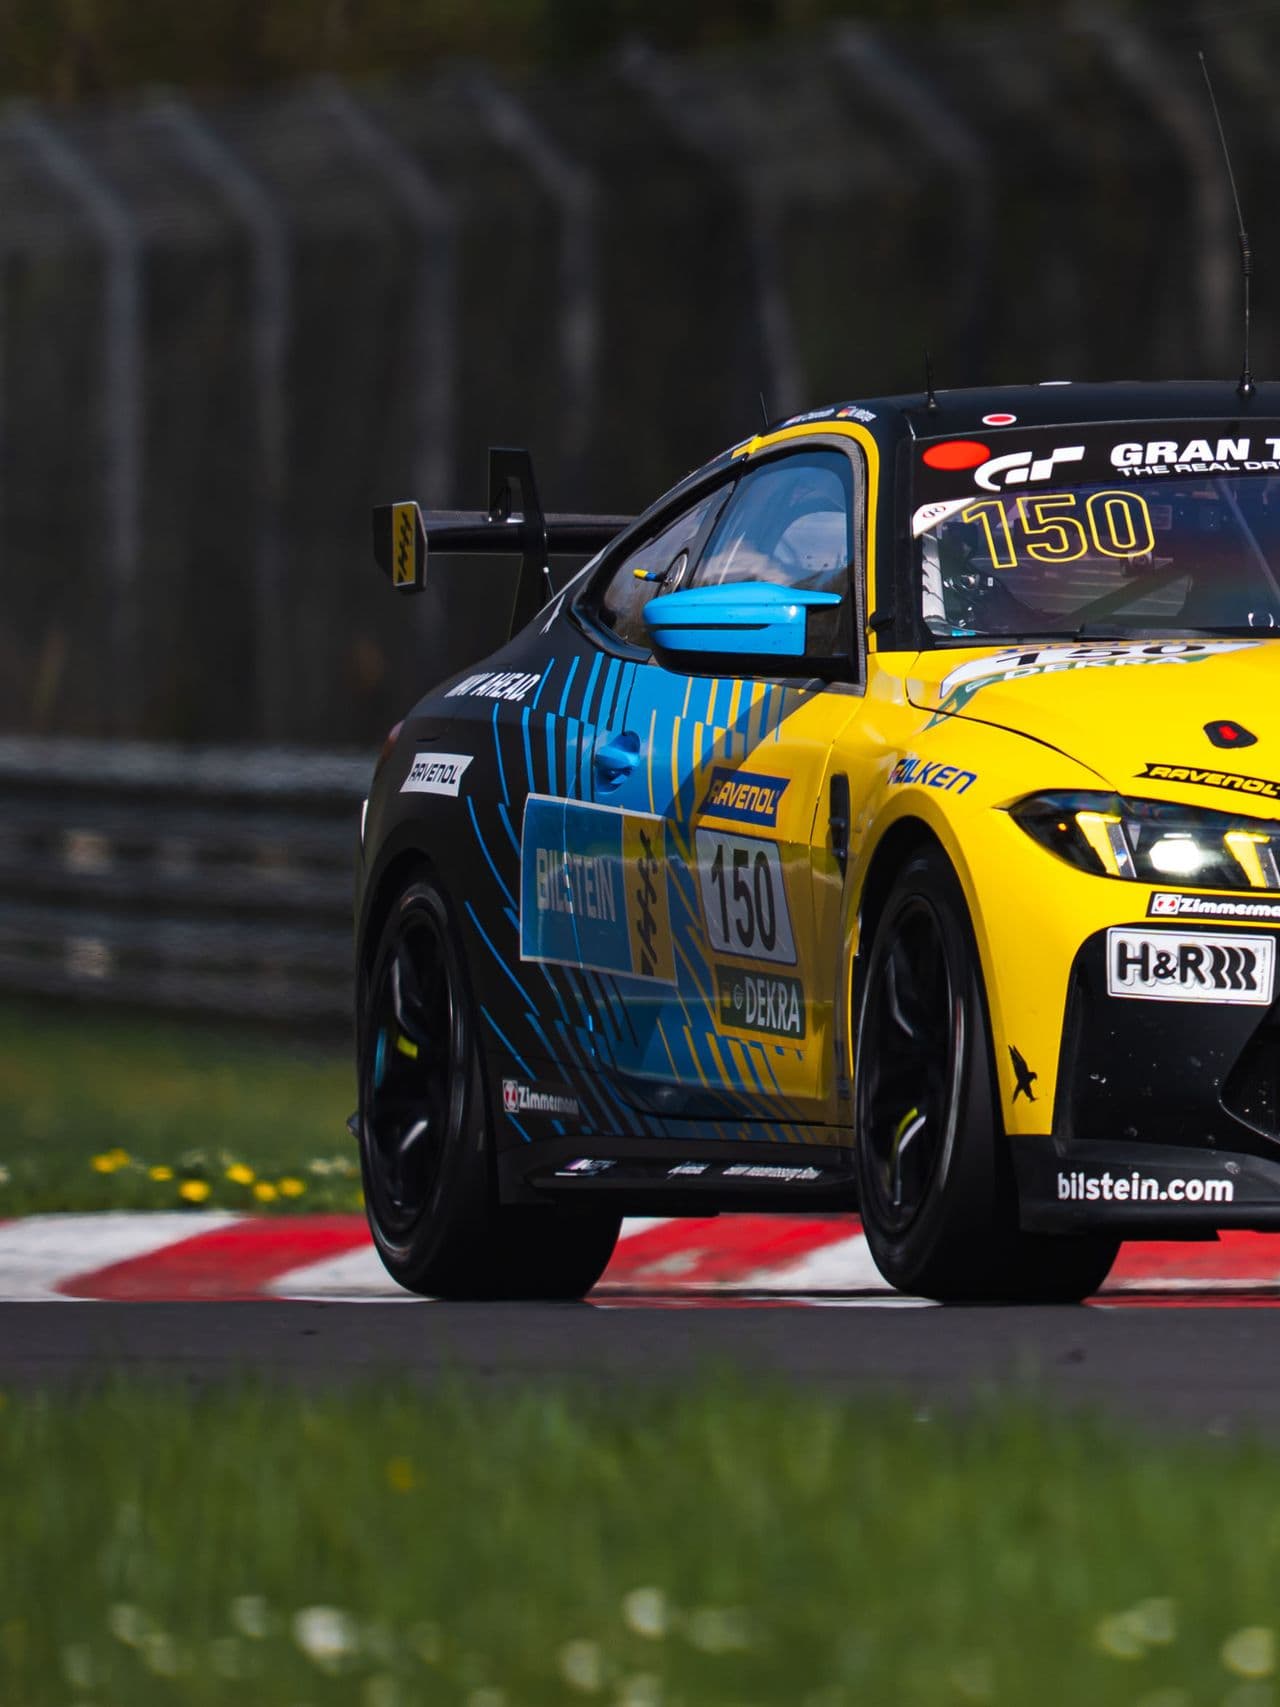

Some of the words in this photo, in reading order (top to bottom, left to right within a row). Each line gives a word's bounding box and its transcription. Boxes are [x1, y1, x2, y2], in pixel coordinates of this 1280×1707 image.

[1110, 438, 1250, 467] GRAN
[1117, 466, 1170, 477] THE
[1174, 462, 1240, 473] REAL
[962, 491, 1155, 569] 150
[1003, 655, 1188, 682] DEKRA
[410, 763, 459, 785] RAVENOL
[886, 758, 977, 795] FALKEN
[709, 780, 777, 814] RAVENOL
[536, 847, 616, 922] BILSTEIN
[710, 844, 776, 953] 150
[1117, 939, 1206, 985] H&R
[744, 976, 801, 1033] DEKRA
[518, 1086, 579, 1115] Zimmer
[1057, 1171, 1234, 1202] bilstein.com
